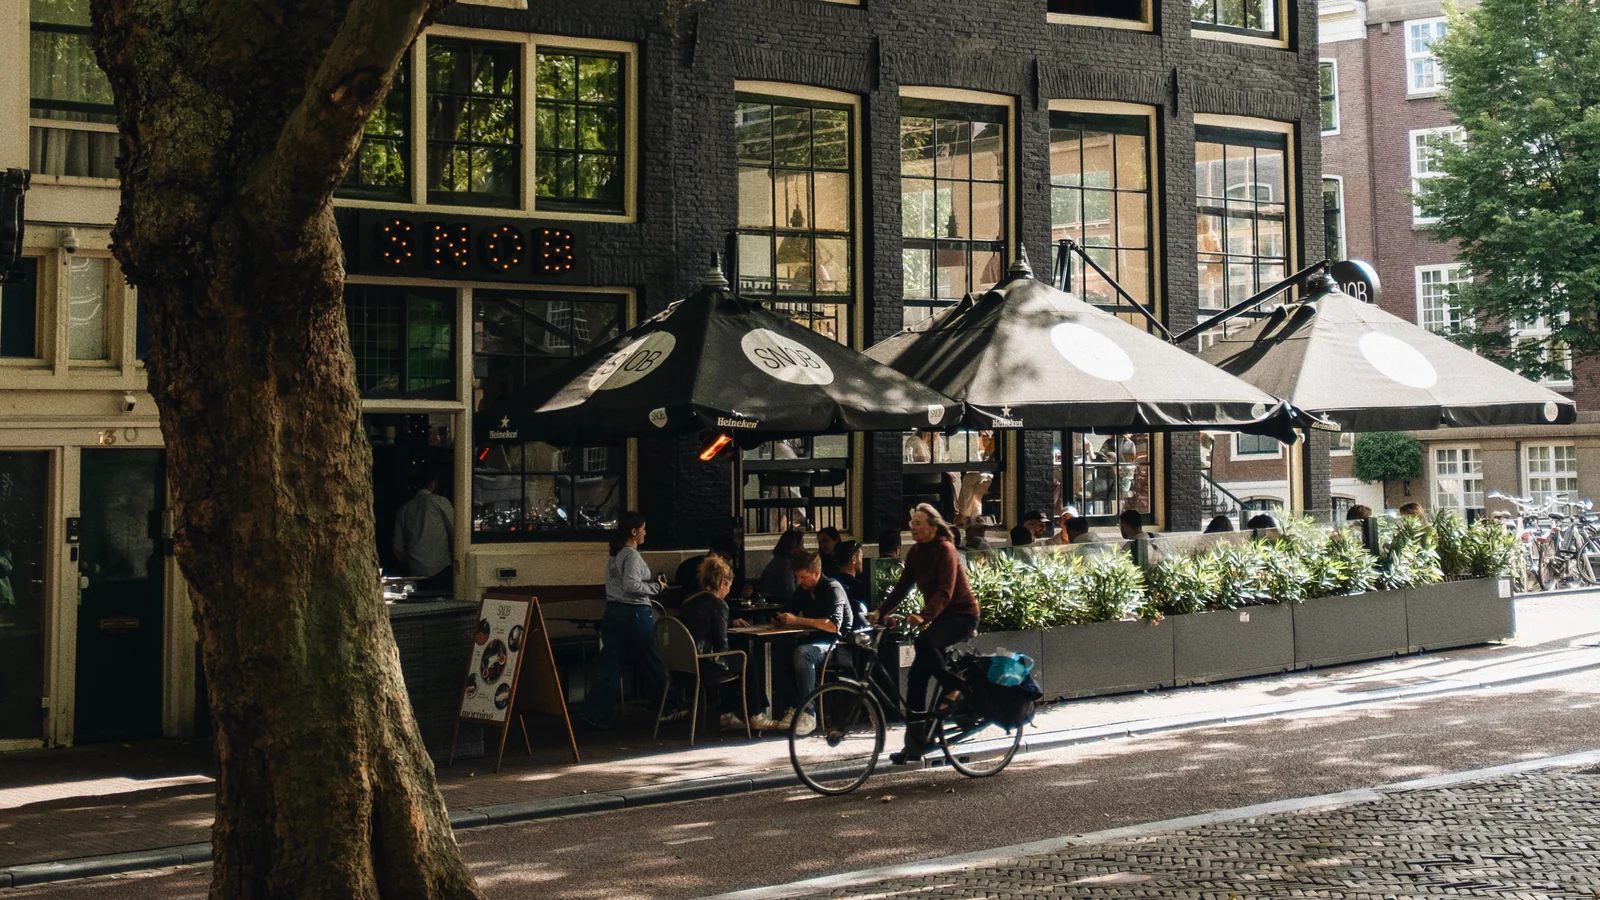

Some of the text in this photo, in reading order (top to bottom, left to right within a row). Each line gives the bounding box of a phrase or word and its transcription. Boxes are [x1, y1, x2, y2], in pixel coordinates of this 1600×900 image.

[373, 217, 576, 275] SNOB
[754, 346, 821, 369] SNOB
[717, 417, 757, 428] Heineken
[992, 419, 1024, 427] Heineken
[98, 427, 138, 445] 130
[489, 430, 518, 439] Heineken
[497, 604, 511, 617] SNOB
